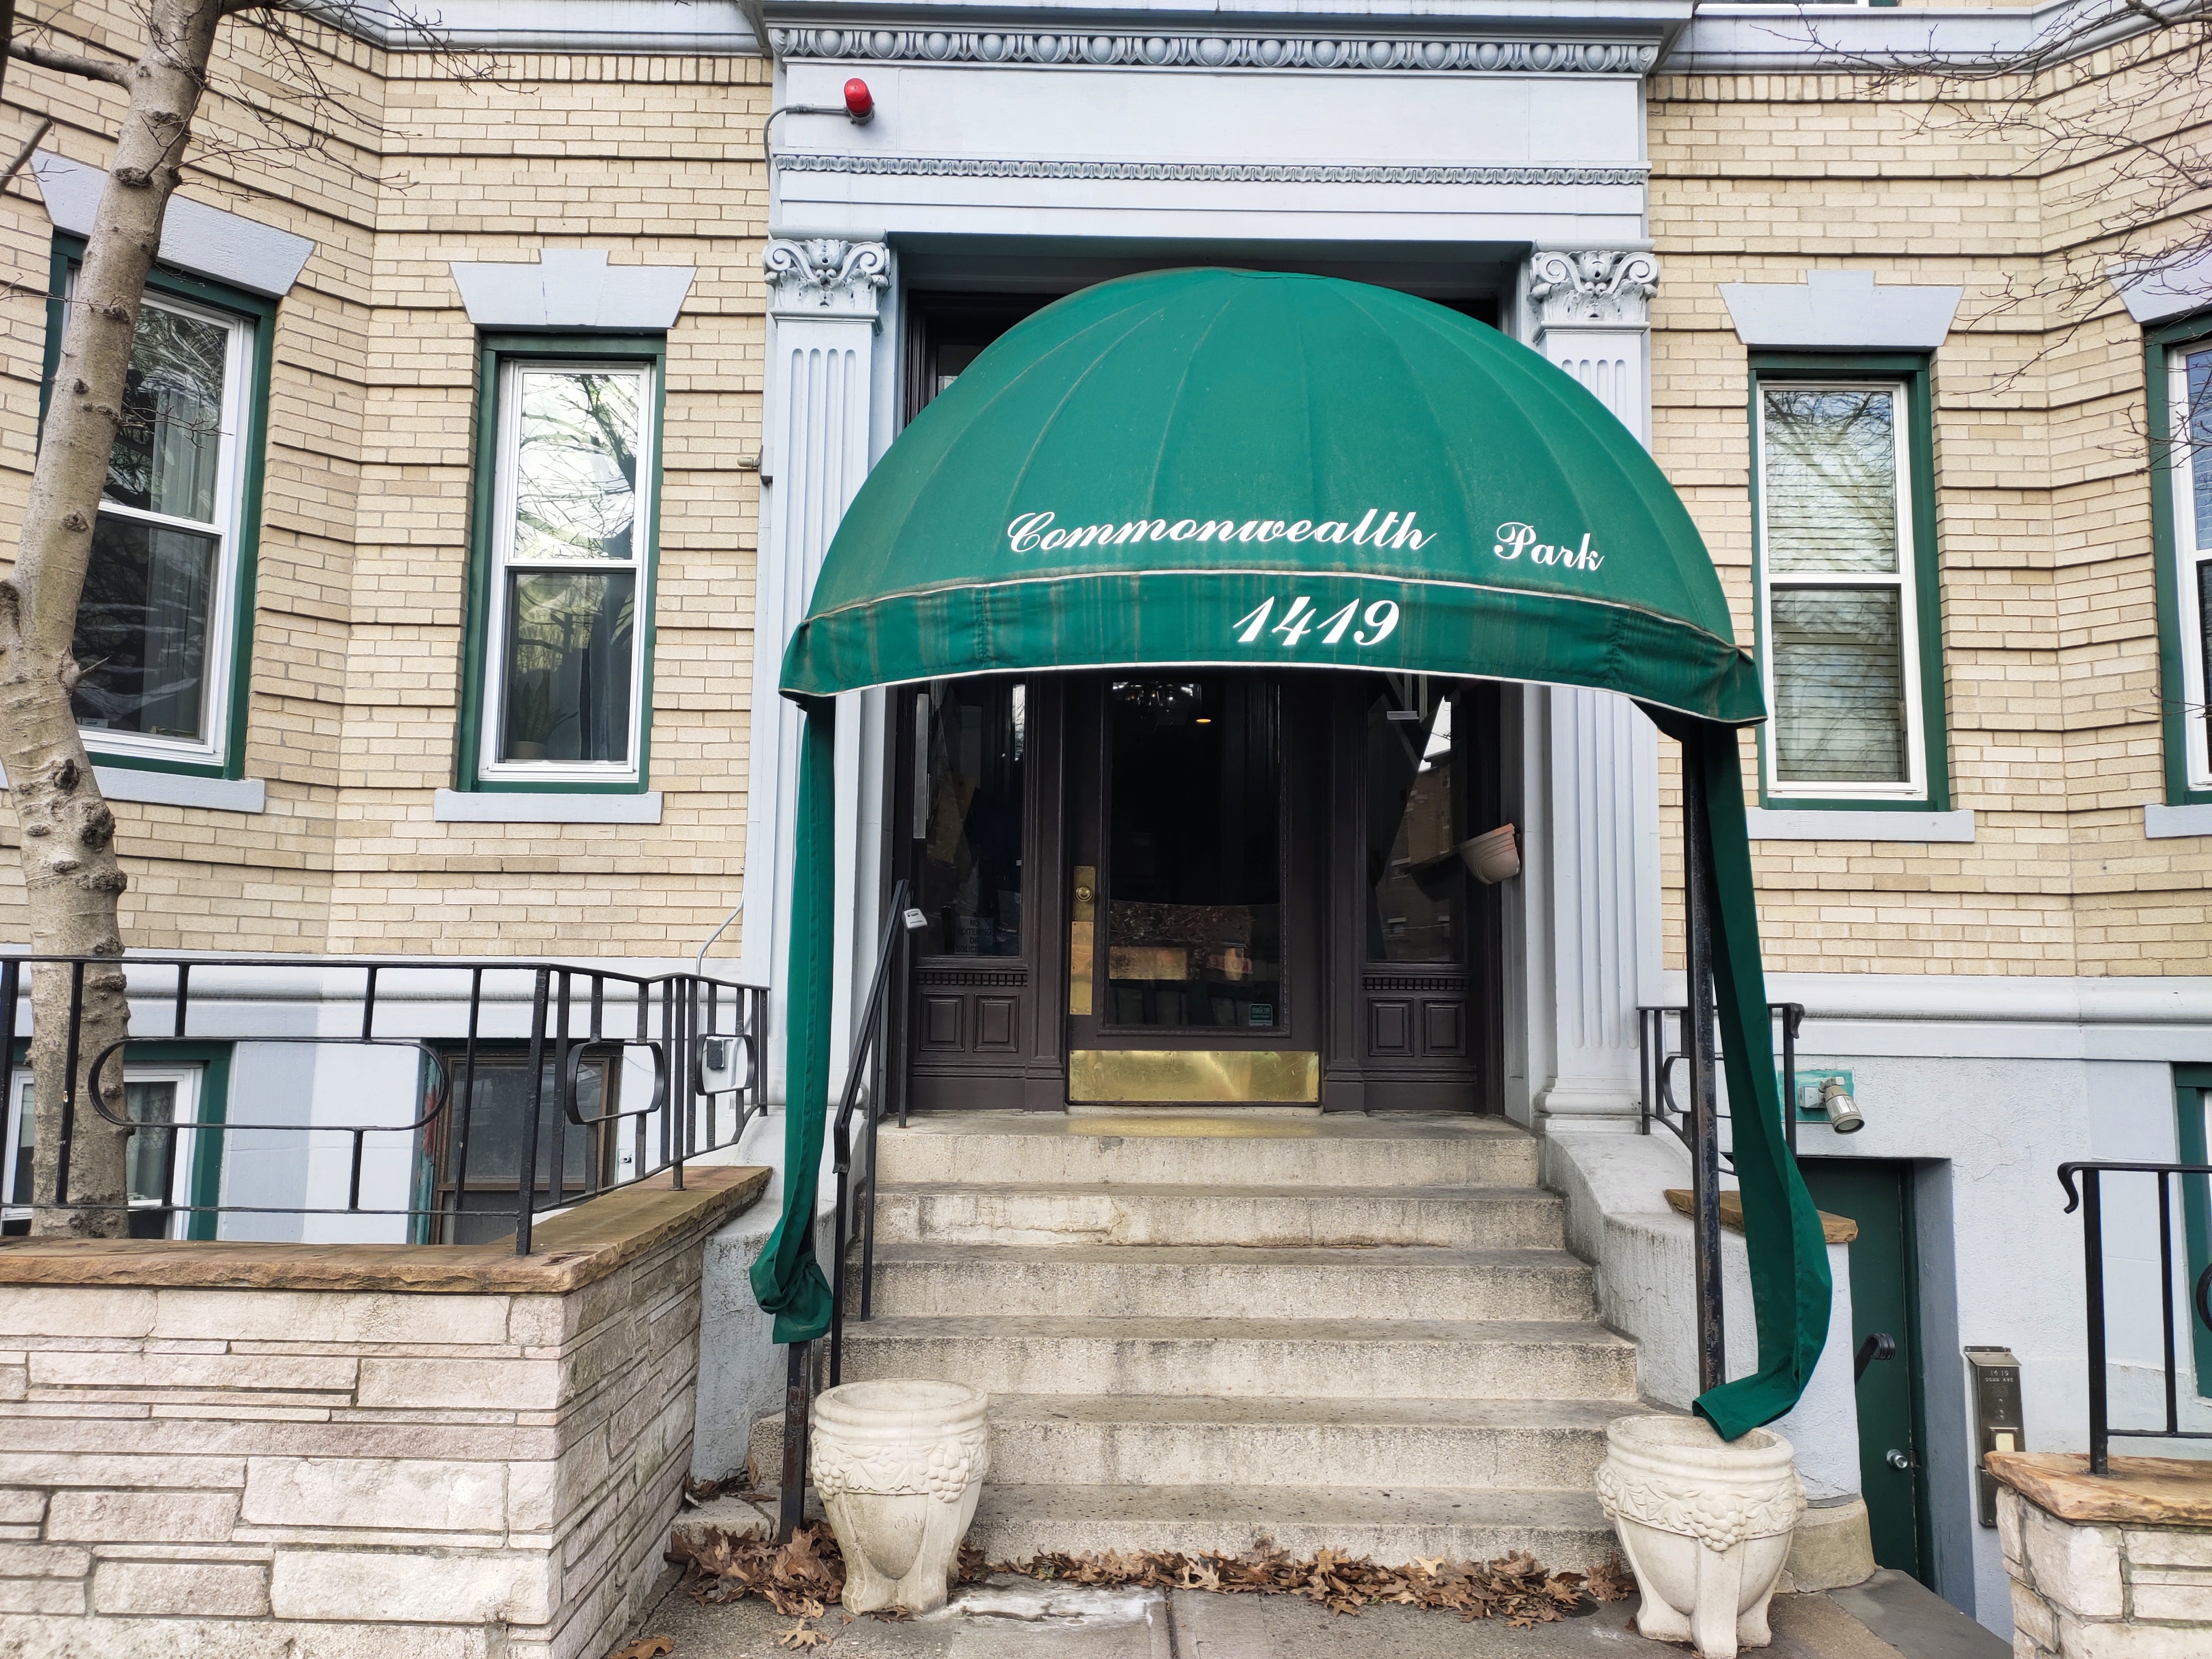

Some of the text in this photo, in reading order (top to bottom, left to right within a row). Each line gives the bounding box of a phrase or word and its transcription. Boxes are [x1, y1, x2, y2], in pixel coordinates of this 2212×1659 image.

[1007, 508, 1604, 571] Commonwealth Park
[1232, 596, 1400, 646] 1419
